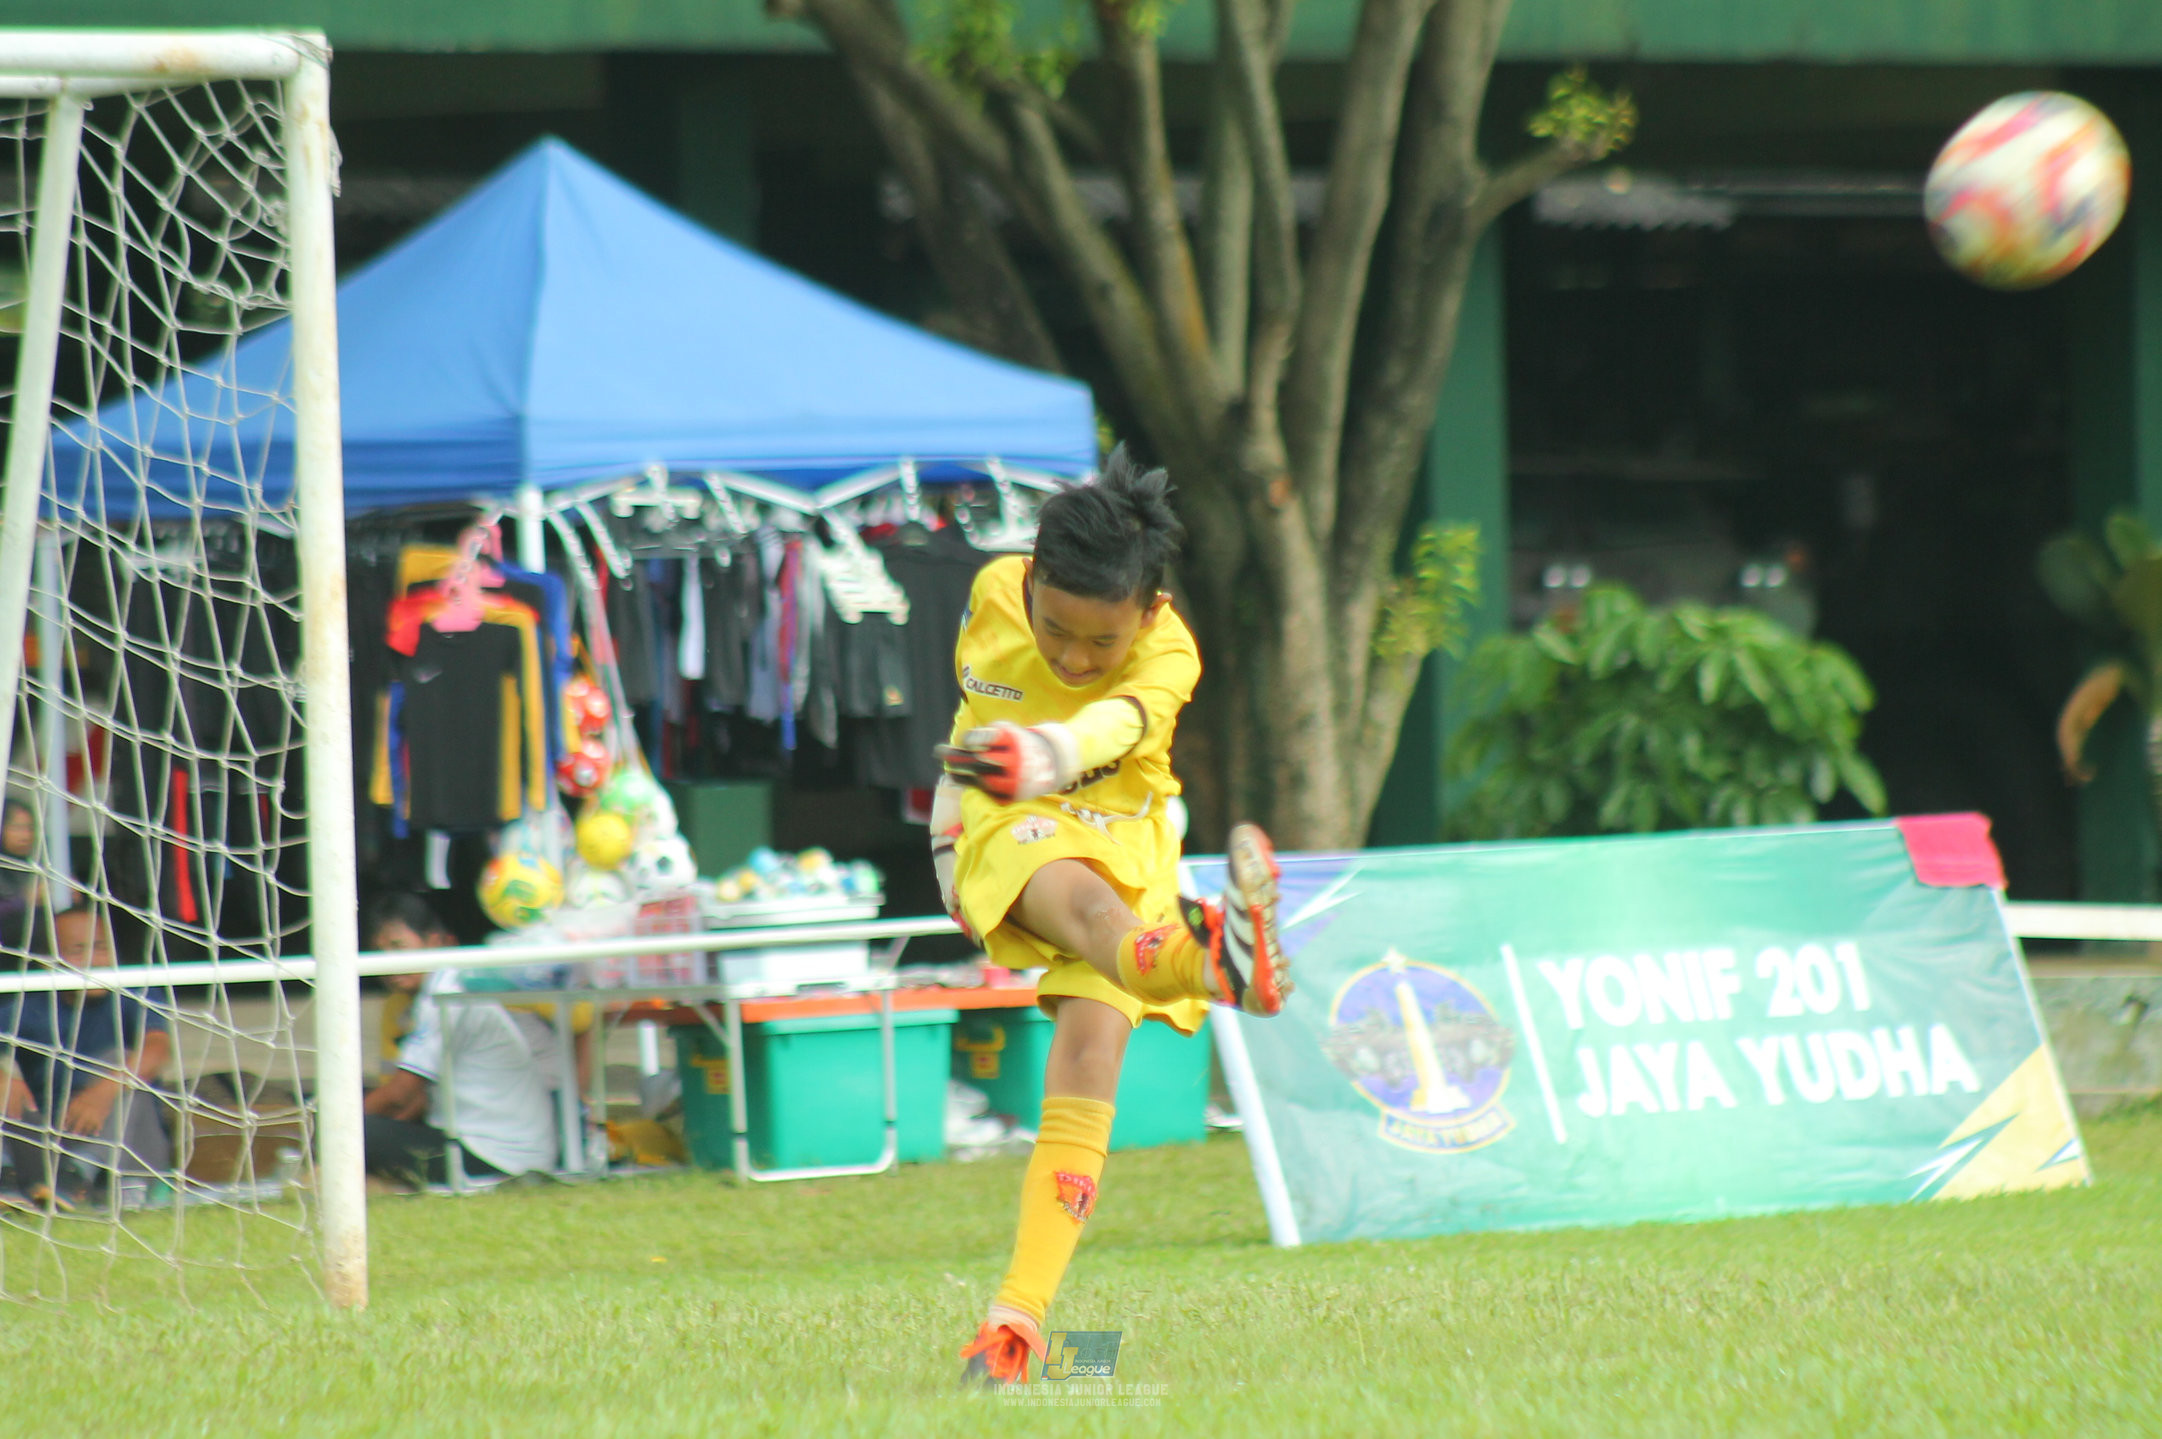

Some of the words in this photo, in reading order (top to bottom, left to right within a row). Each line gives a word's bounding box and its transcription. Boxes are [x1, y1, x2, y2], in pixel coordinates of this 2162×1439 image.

[965, 678, 1024, 700] CALCETTO
[1536, 945, 1742, 1030] YONIF
[1756, 940, 1871, 1018] 201
[1576, 1040, 1738, 1118] JAYA
[1735, 1022, 1982, 1106] YUDHA
